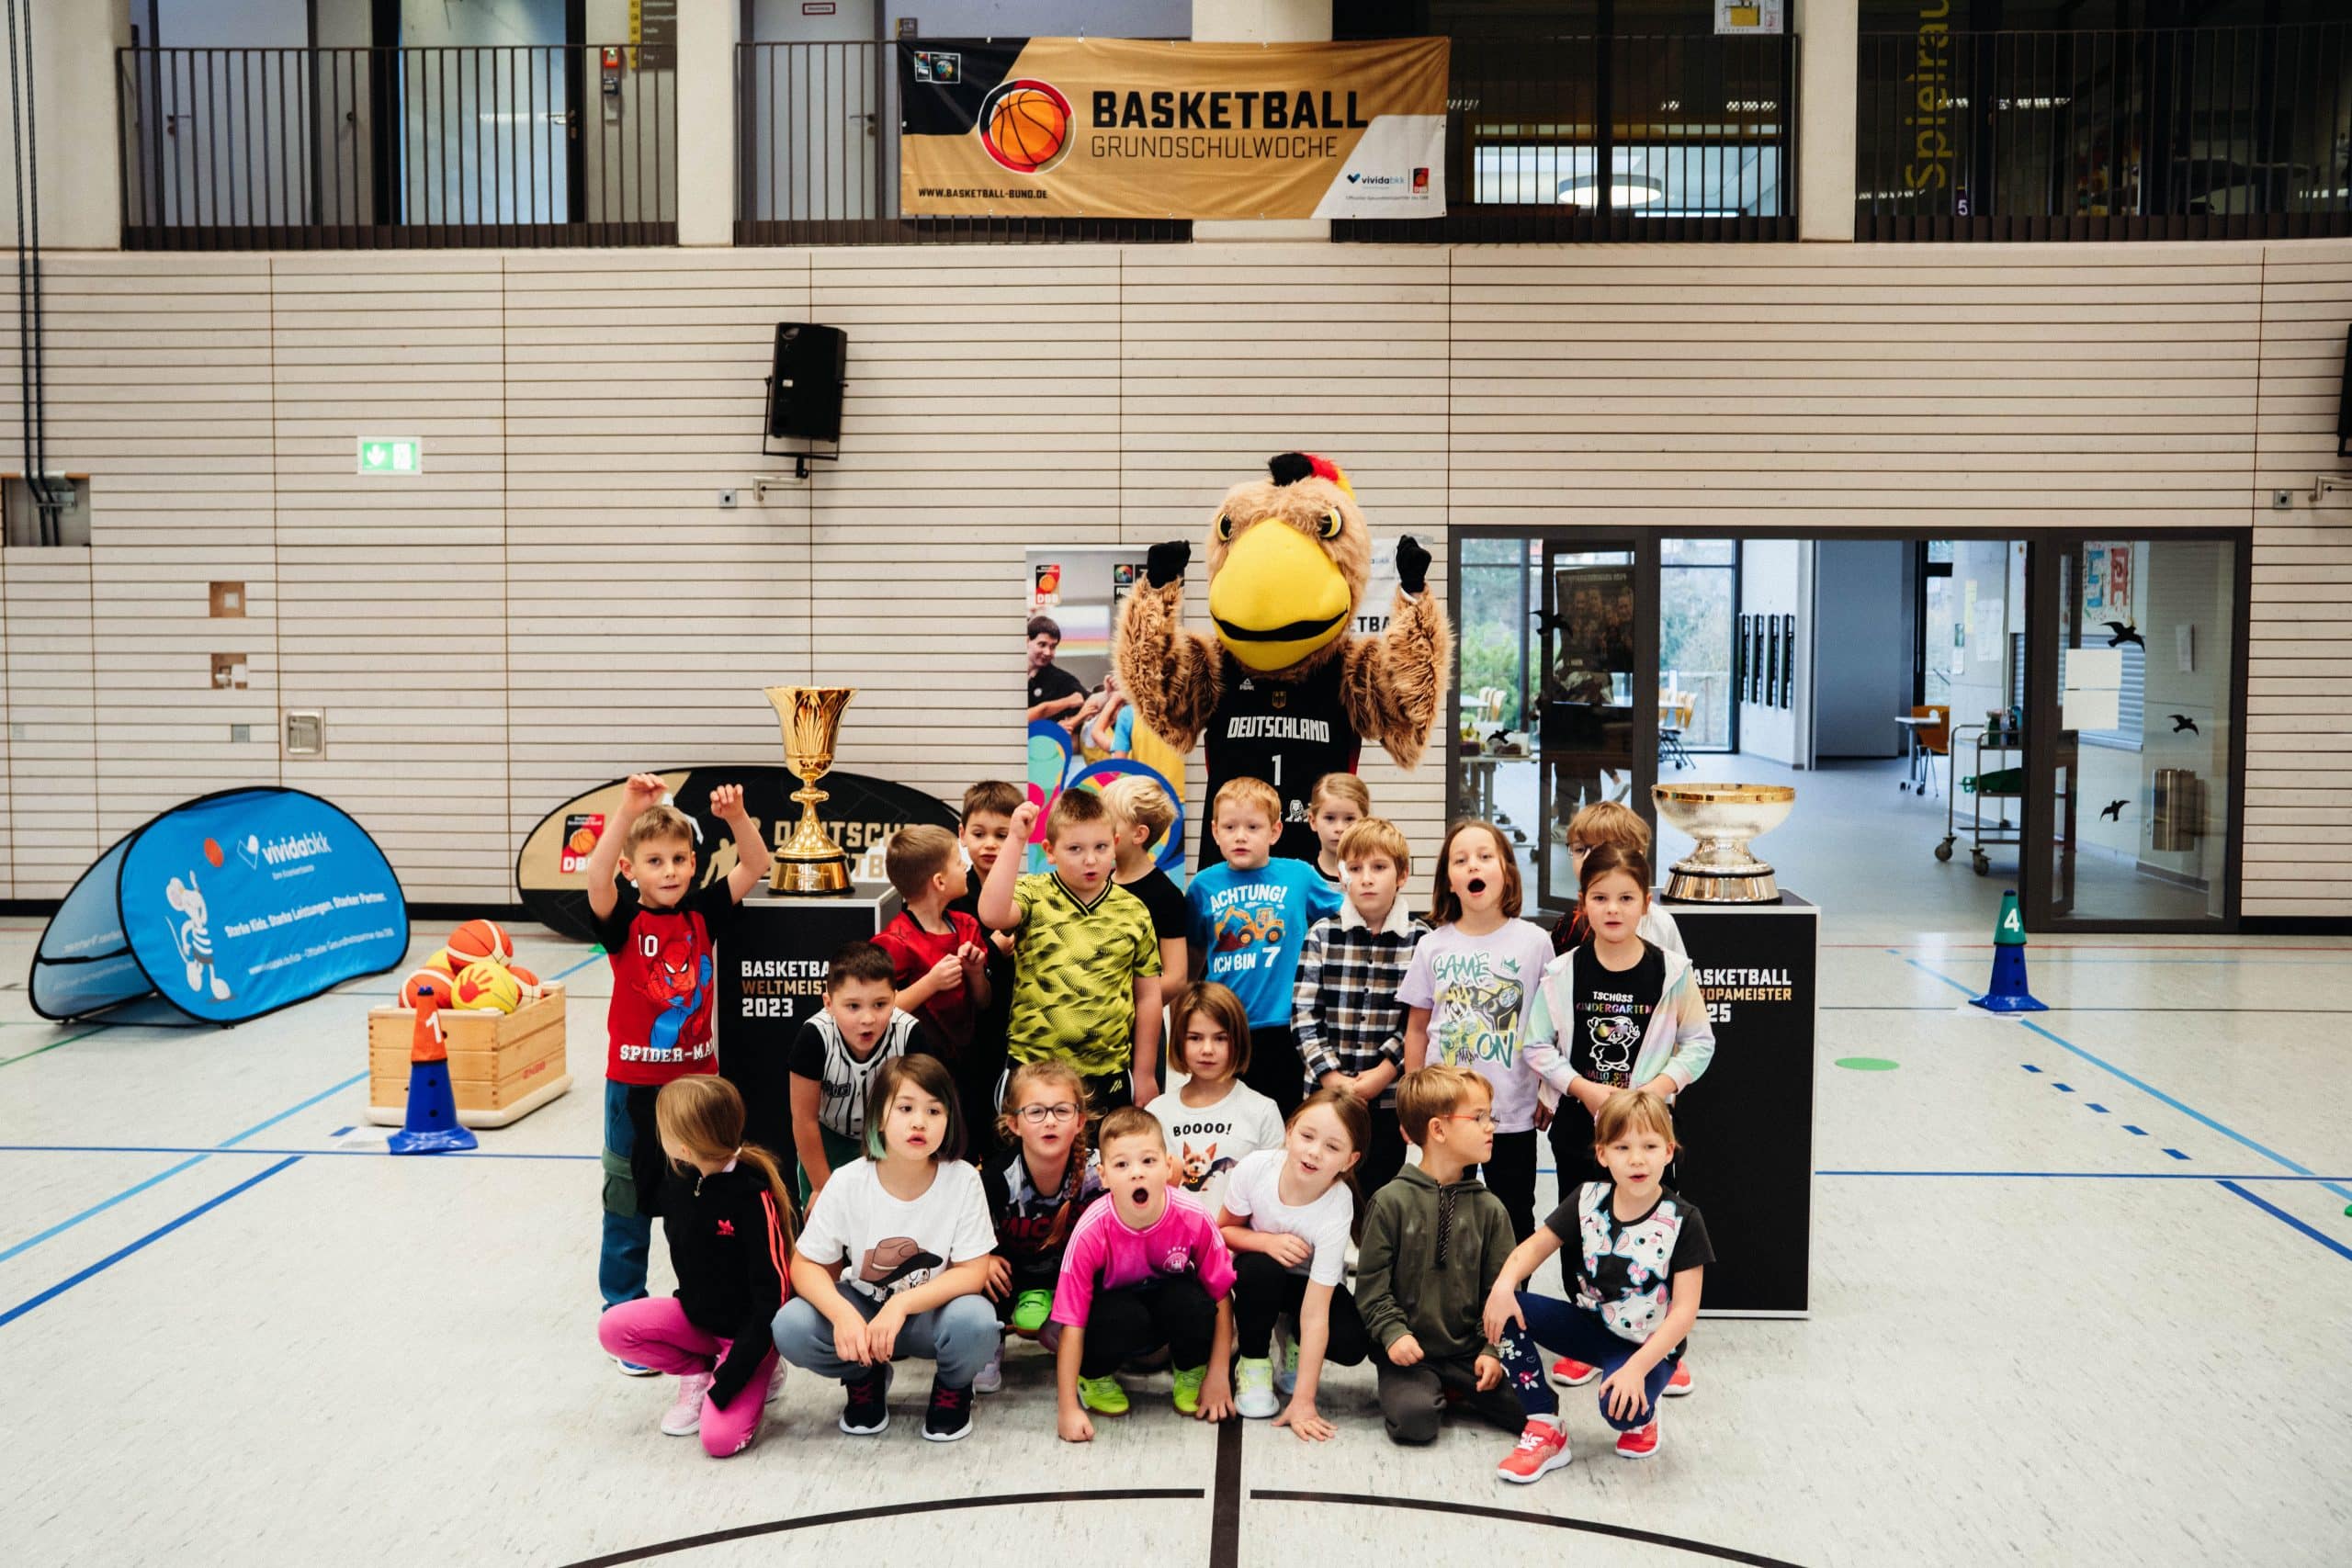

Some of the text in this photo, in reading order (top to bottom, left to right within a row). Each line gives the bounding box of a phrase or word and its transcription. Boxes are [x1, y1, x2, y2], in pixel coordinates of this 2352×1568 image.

[1091, 90, 1369, 130] BASKETBALL
[1091, 136, 1339, 159] GRUNDSCHULWOCHE
[918, 187, 1048, 199] WWW.BASKETBALL-BUND.DE
[1957, 199, 1968, 217] 5
[1227, 716, 1330, 743] DEUTSCHLAND
[1272, 754, 1282, 786] 1
[261, 830, 333, 865] vividabkk
[1209, 883, 1288, 913] ACHTUNG!
[2003, 908, 2020, 933] 4
[741, 960, 831, 977] BASKETBA
[1213, 945, 1282, 974] ICH BIN 7
[1432, 951, 1493, 987] GAME
[1693, 968, 1792, 986] ASKETBALL
[741, 998, 794, 1017] 2023
[1706, 1002, 1732, 1023] 25
[425, 1010, 442, 1044] 1
[619, 1036, 715, 1063] SPIDER-MA
[1476, 1031, 1515, 1069] ON
[1612, 1072, 1632, 1082] SCH
[1172, 1122, 1233, 1138] BOOOO!
